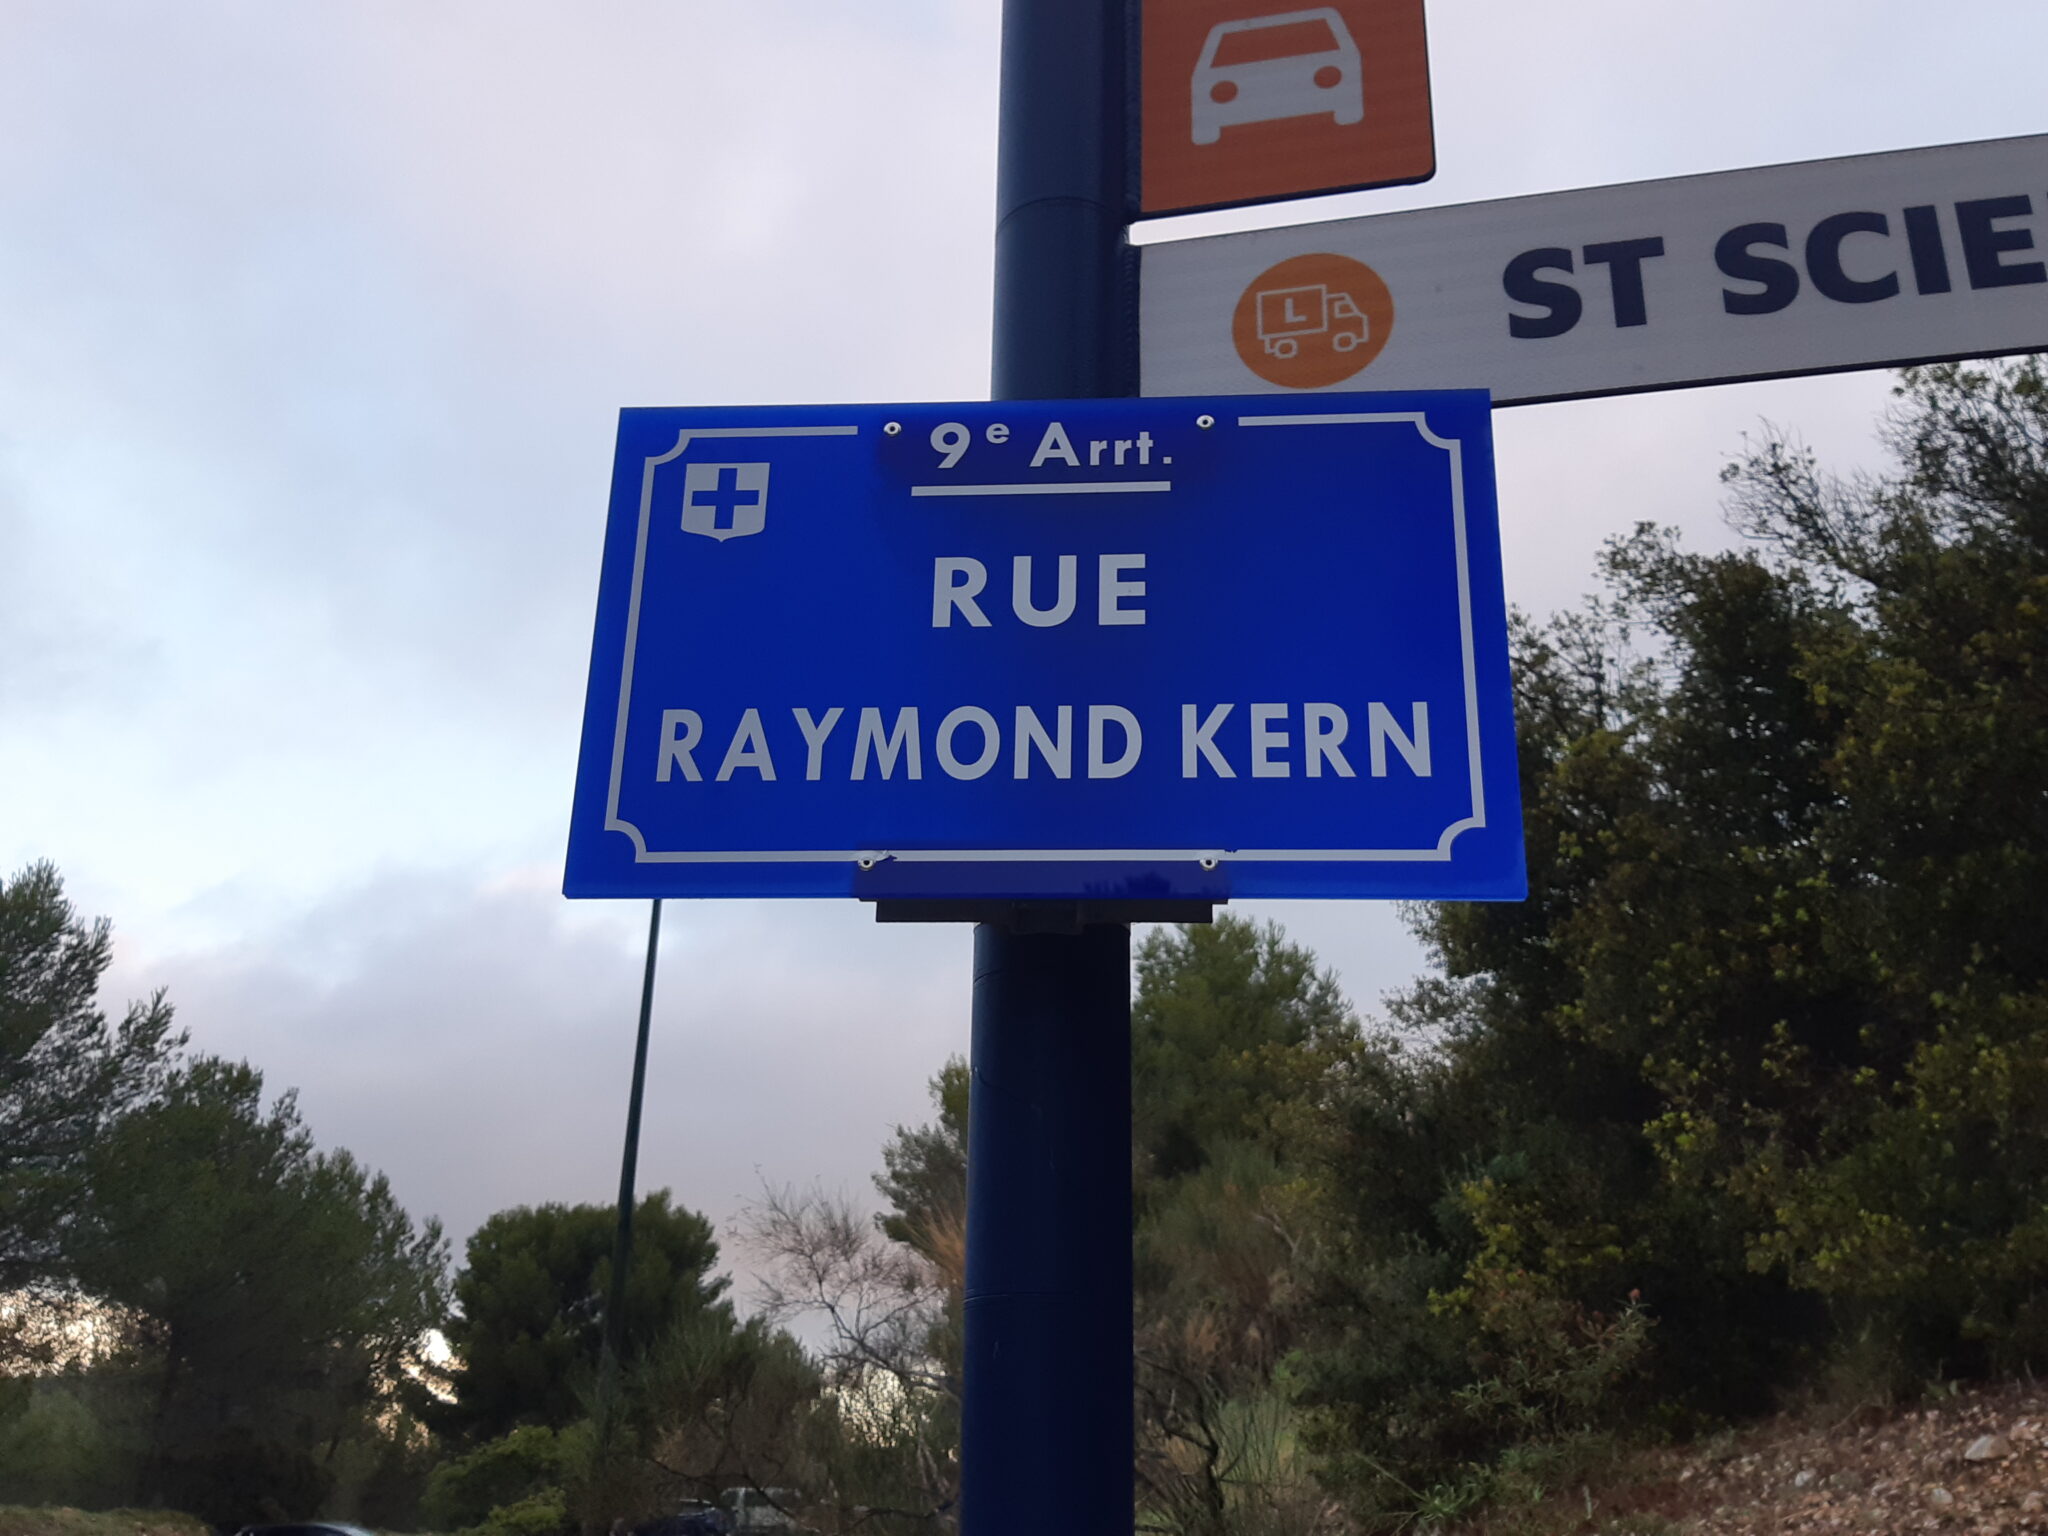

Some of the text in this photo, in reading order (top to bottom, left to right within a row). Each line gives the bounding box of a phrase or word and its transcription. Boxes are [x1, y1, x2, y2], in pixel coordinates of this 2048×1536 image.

[1502, 192, 2048, 340] ST SCIE
[1029, 421, 1173, 468] Arrt.
[931, 553, 1148, 629] RUE
[655, 701, 1434, 783] RAYMOND KERN
